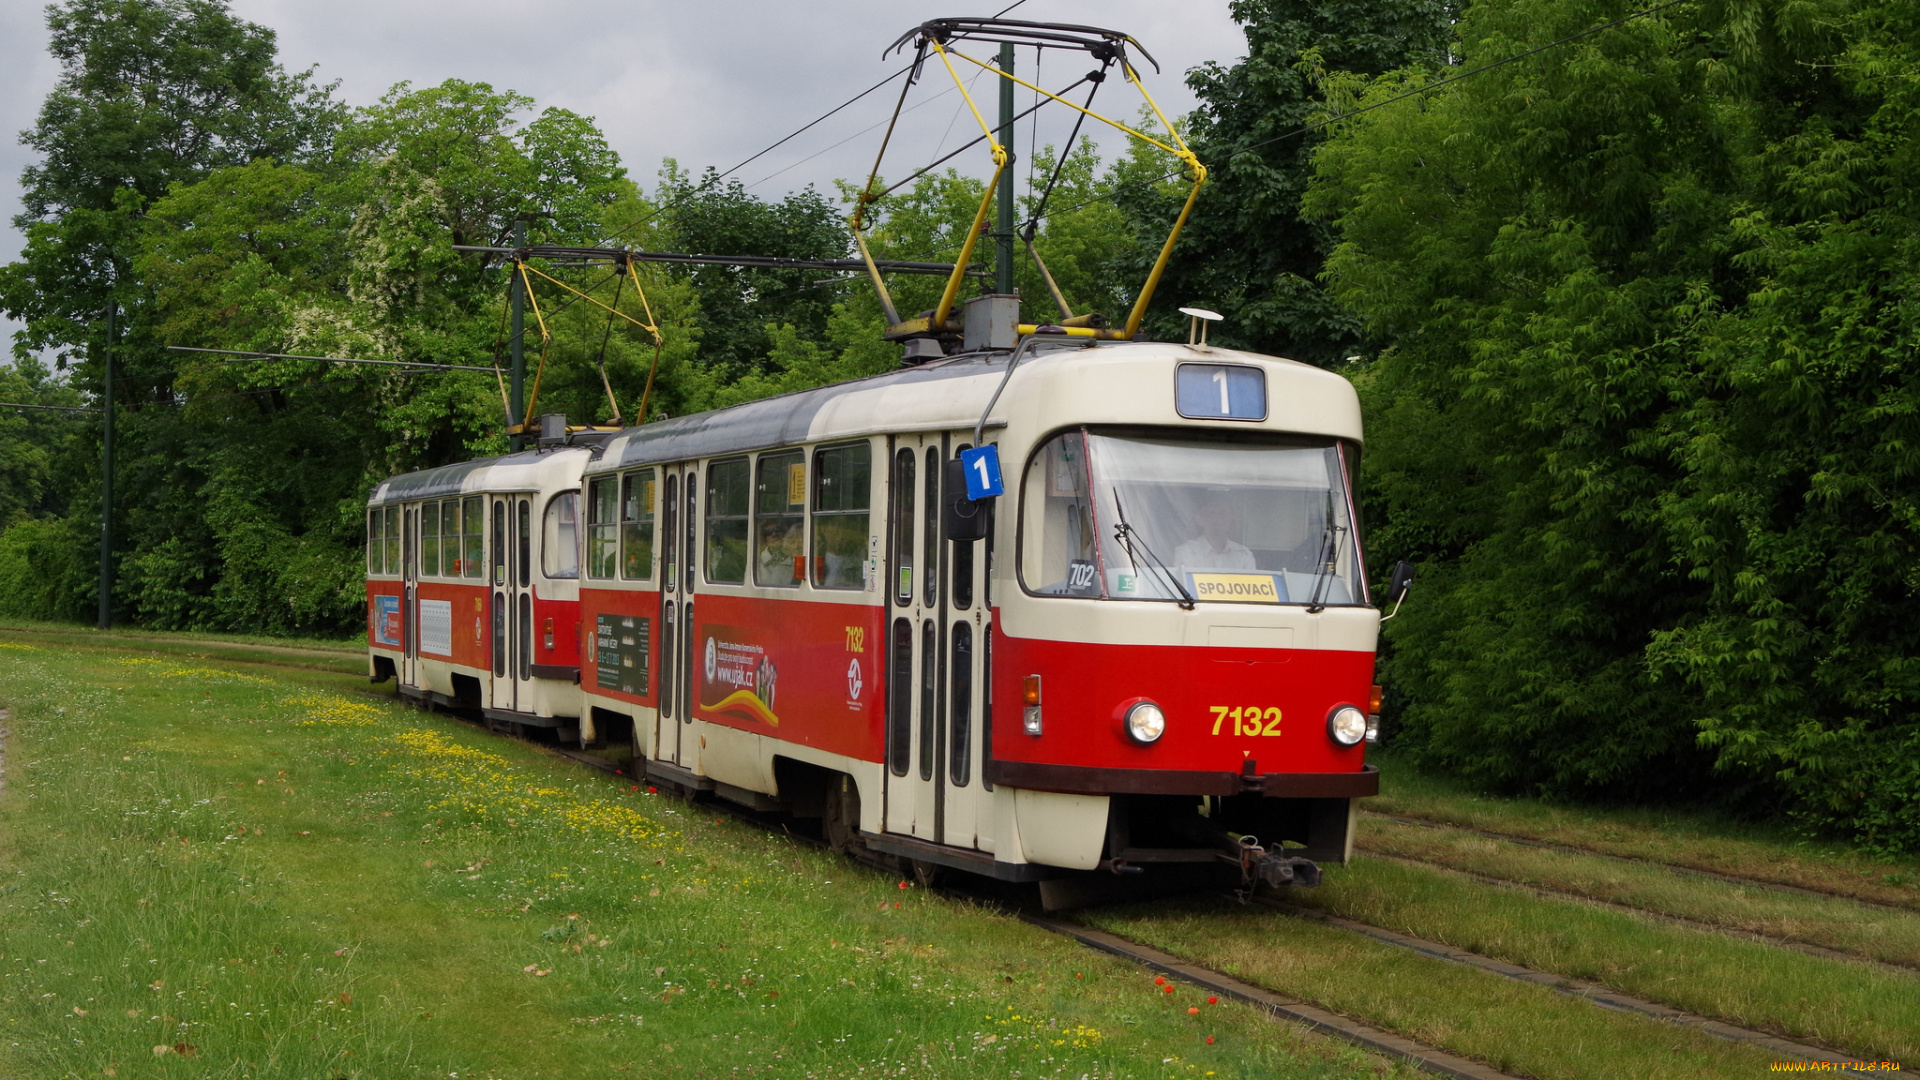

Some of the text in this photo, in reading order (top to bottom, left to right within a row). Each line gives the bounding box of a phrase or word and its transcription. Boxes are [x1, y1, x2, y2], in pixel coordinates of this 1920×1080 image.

[1212, 368, 1230, 414] 1
[973, 455, 991, 490] 1
[1070, 564, 1095, 587] 702
[1199, 581, 1275, 596] SPOJOVACÍ
[845, 626, 864, 653] 7132
[717, 665, 753, 690] www.ujak.cz
[1209, 706, 1282, 737] 7132
